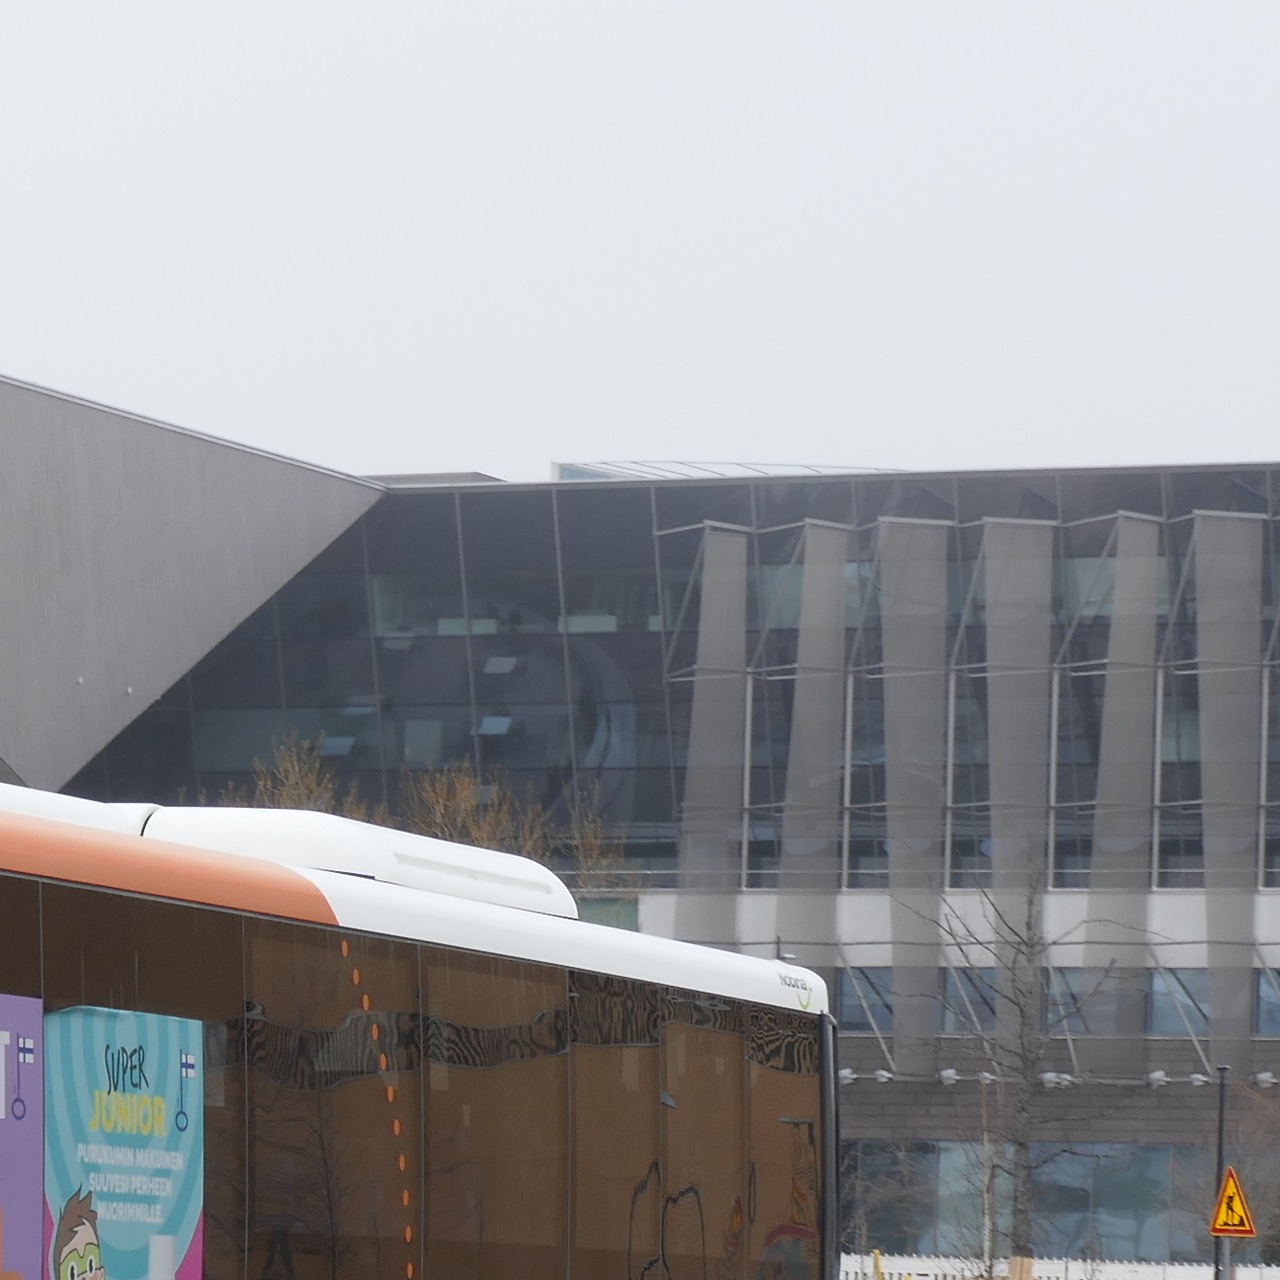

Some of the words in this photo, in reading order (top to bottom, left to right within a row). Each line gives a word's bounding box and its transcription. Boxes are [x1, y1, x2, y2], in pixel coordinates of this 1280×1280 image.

[105, 1044, 150, 1095] SUPER
[89, 1089, 167, 1137] JUNIOR
[77, 1143, 134, 1166] PURUKUMIN
[135, 1148, 184, 1170] MAKUINEN
[88, 1172, 130, 1194] SUUVESI
[131, 1176, 171, 1197] PERHEEN
